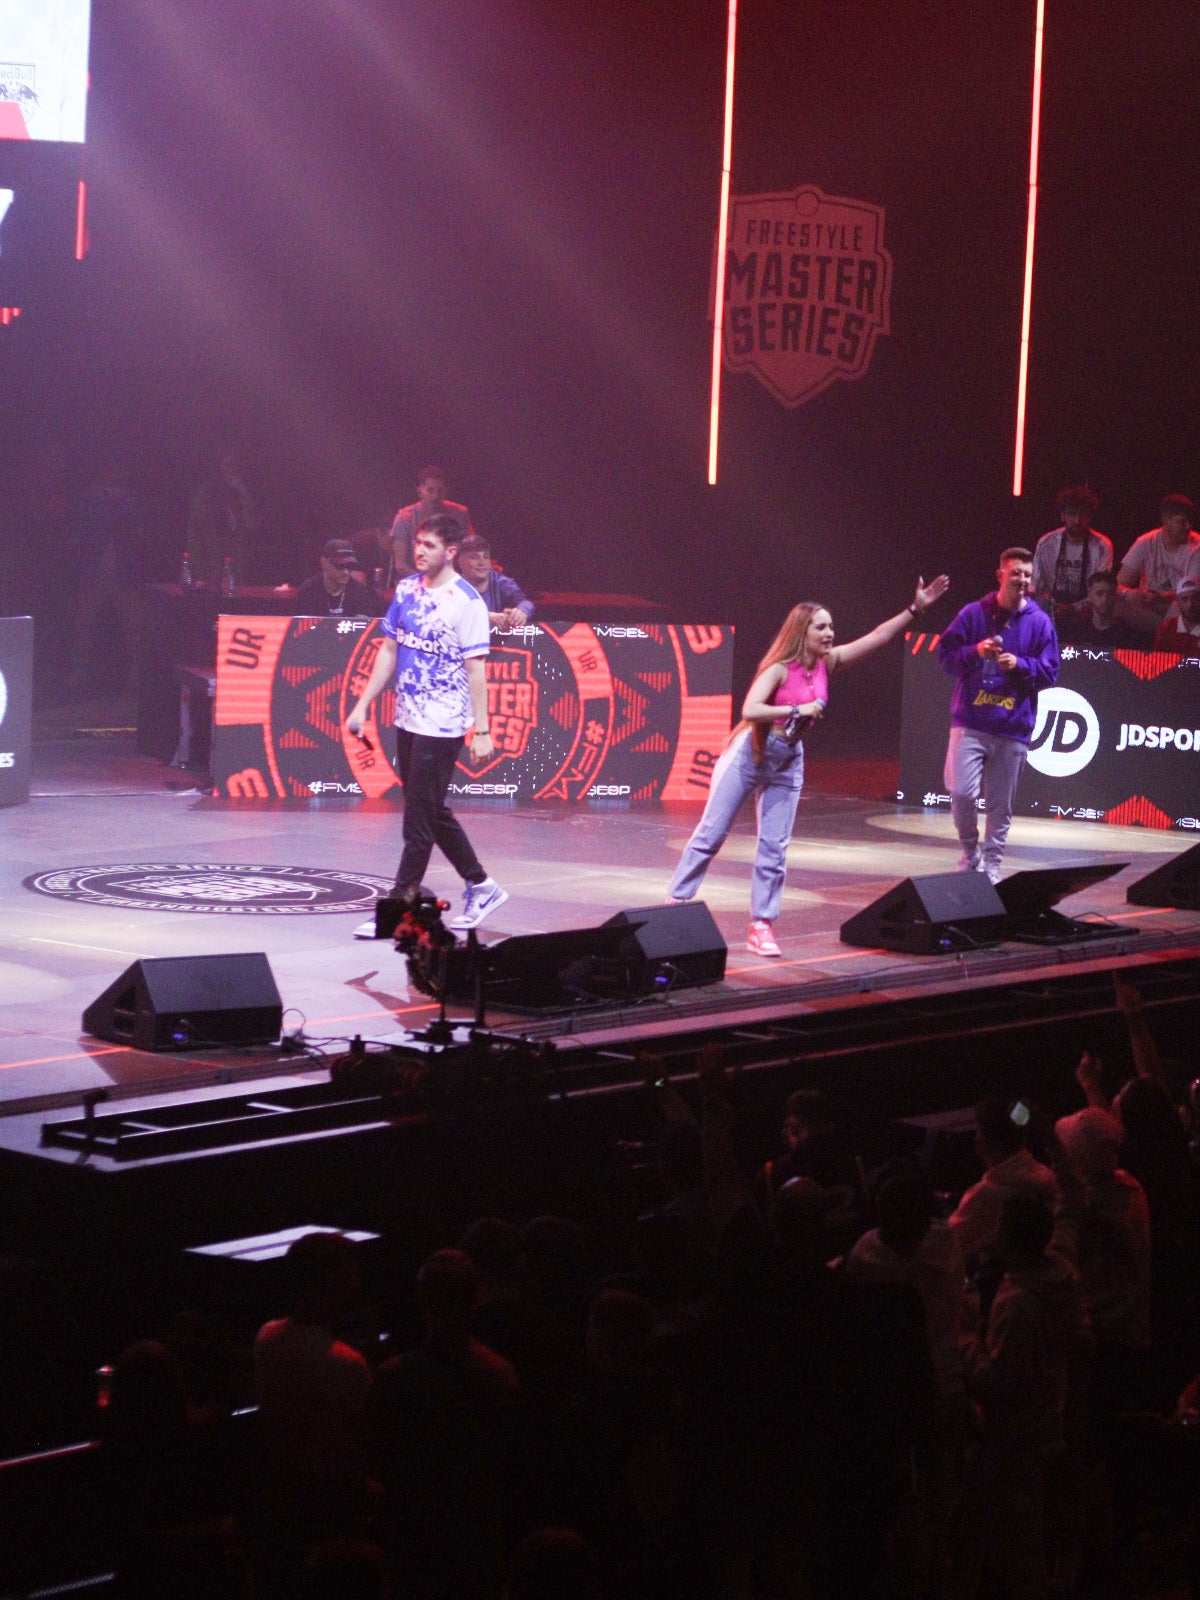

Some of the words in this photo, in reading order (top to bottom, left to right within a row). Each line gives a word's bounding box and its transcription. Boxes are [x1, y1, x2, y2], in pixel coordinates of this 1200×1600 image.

[747, 219, 864, 252] FREESTYLE
[725, 250, 879, 315] MASTER
[731, 303, 866, 362] SERIES
[226, 627, 266, 670] UR
[973, 689, 1016, 711] LAKERS
[1030, 709, 1089, 754] JD
